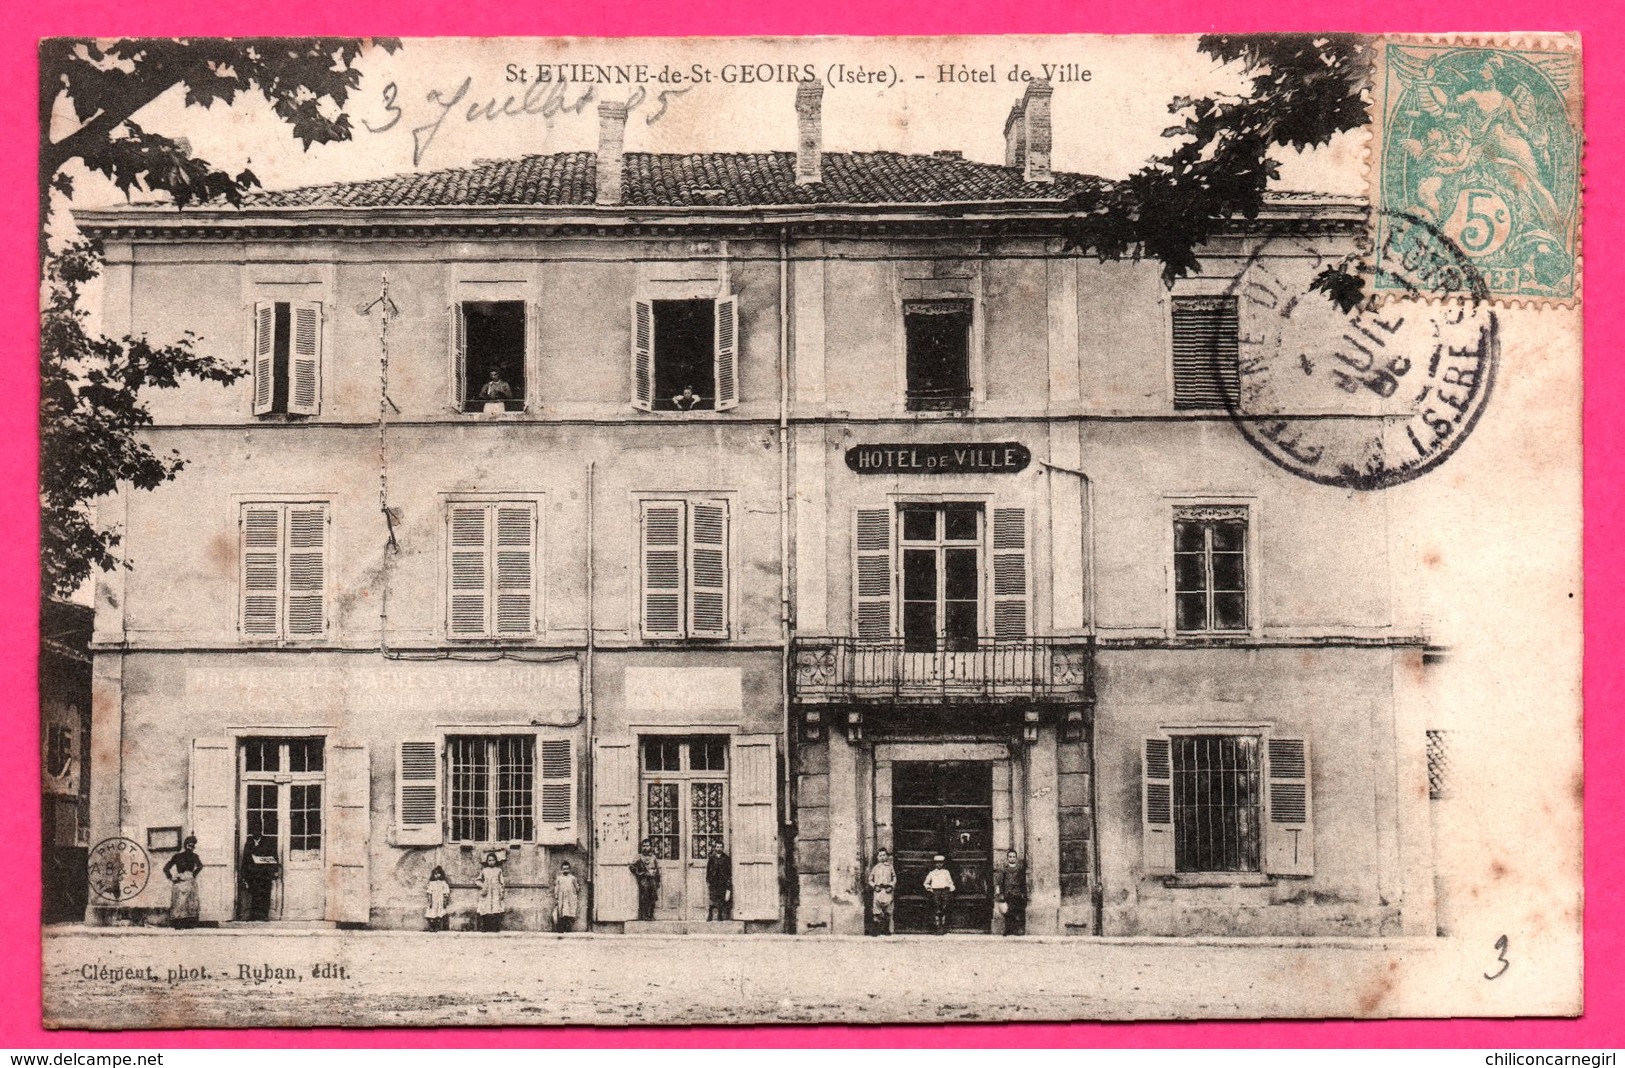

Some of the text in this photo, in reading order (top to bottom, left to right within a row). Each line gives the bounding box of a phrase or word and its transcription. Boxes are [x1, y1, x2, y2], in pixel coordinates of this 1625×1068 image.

[859, 449, 1017, 468] HOTEL DE VILLE
[1483, 934, 1510, 981] 3
